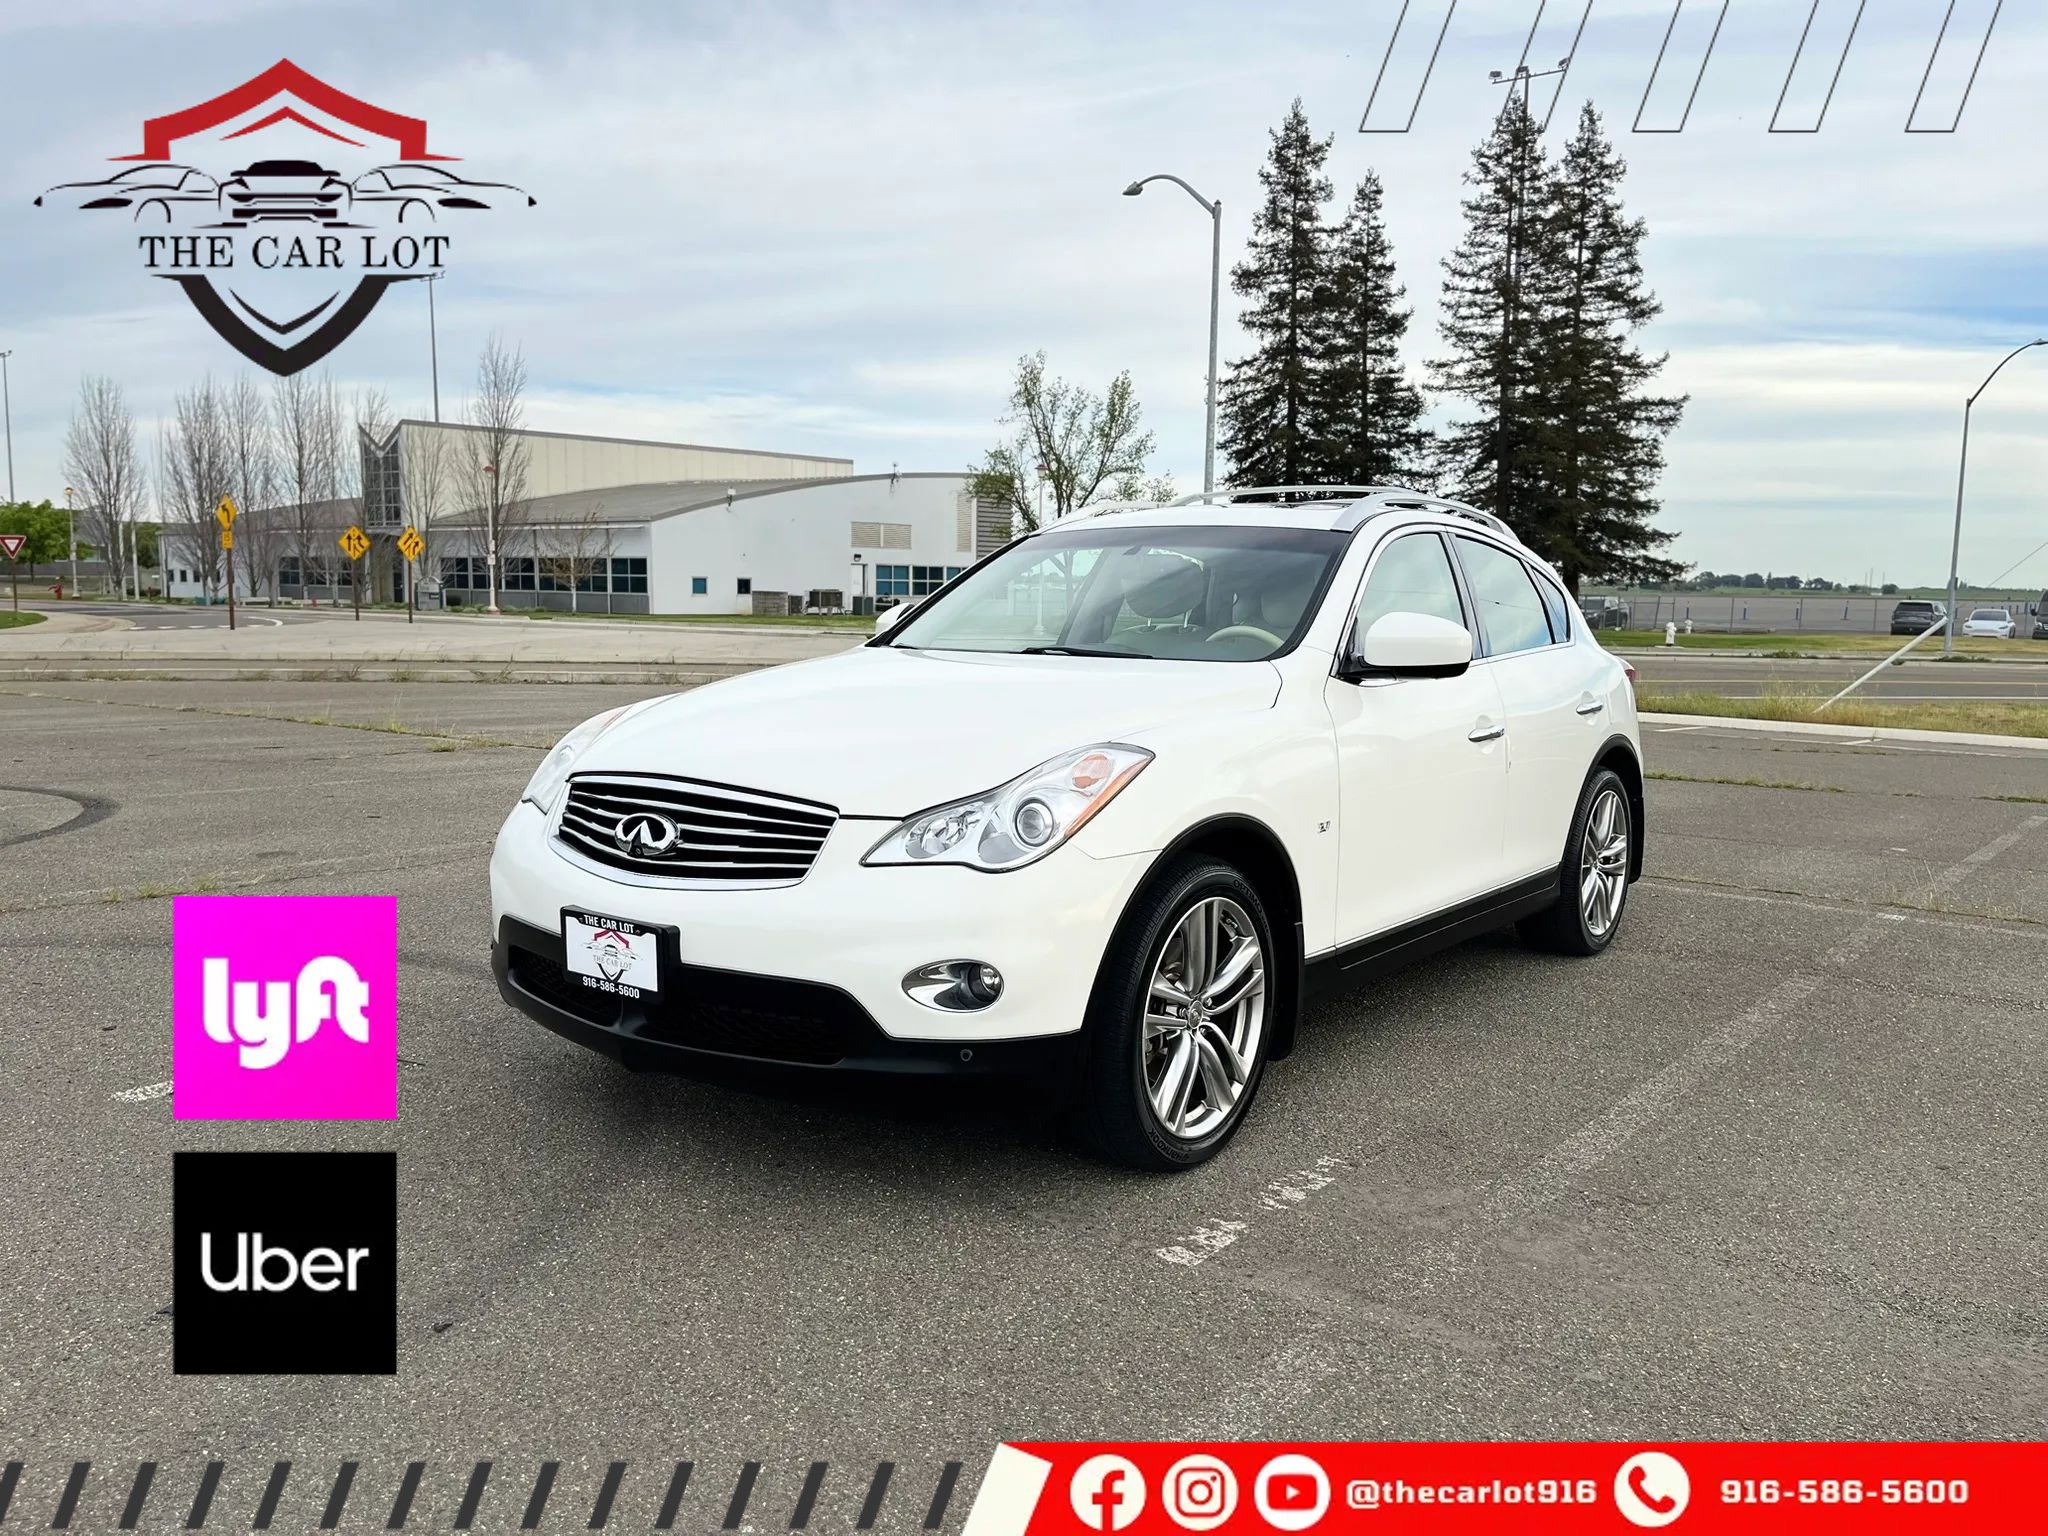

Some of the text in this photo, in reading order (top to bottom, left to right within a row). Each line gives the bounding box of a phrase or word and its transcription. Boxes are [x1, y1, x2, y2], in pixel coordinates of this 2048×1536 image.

[583, 914, 634, 934] THE CAR LOT
[593, 954, 632, 970] THE CAR LOT
[582, 975, 640, 999] 916-586-5600
